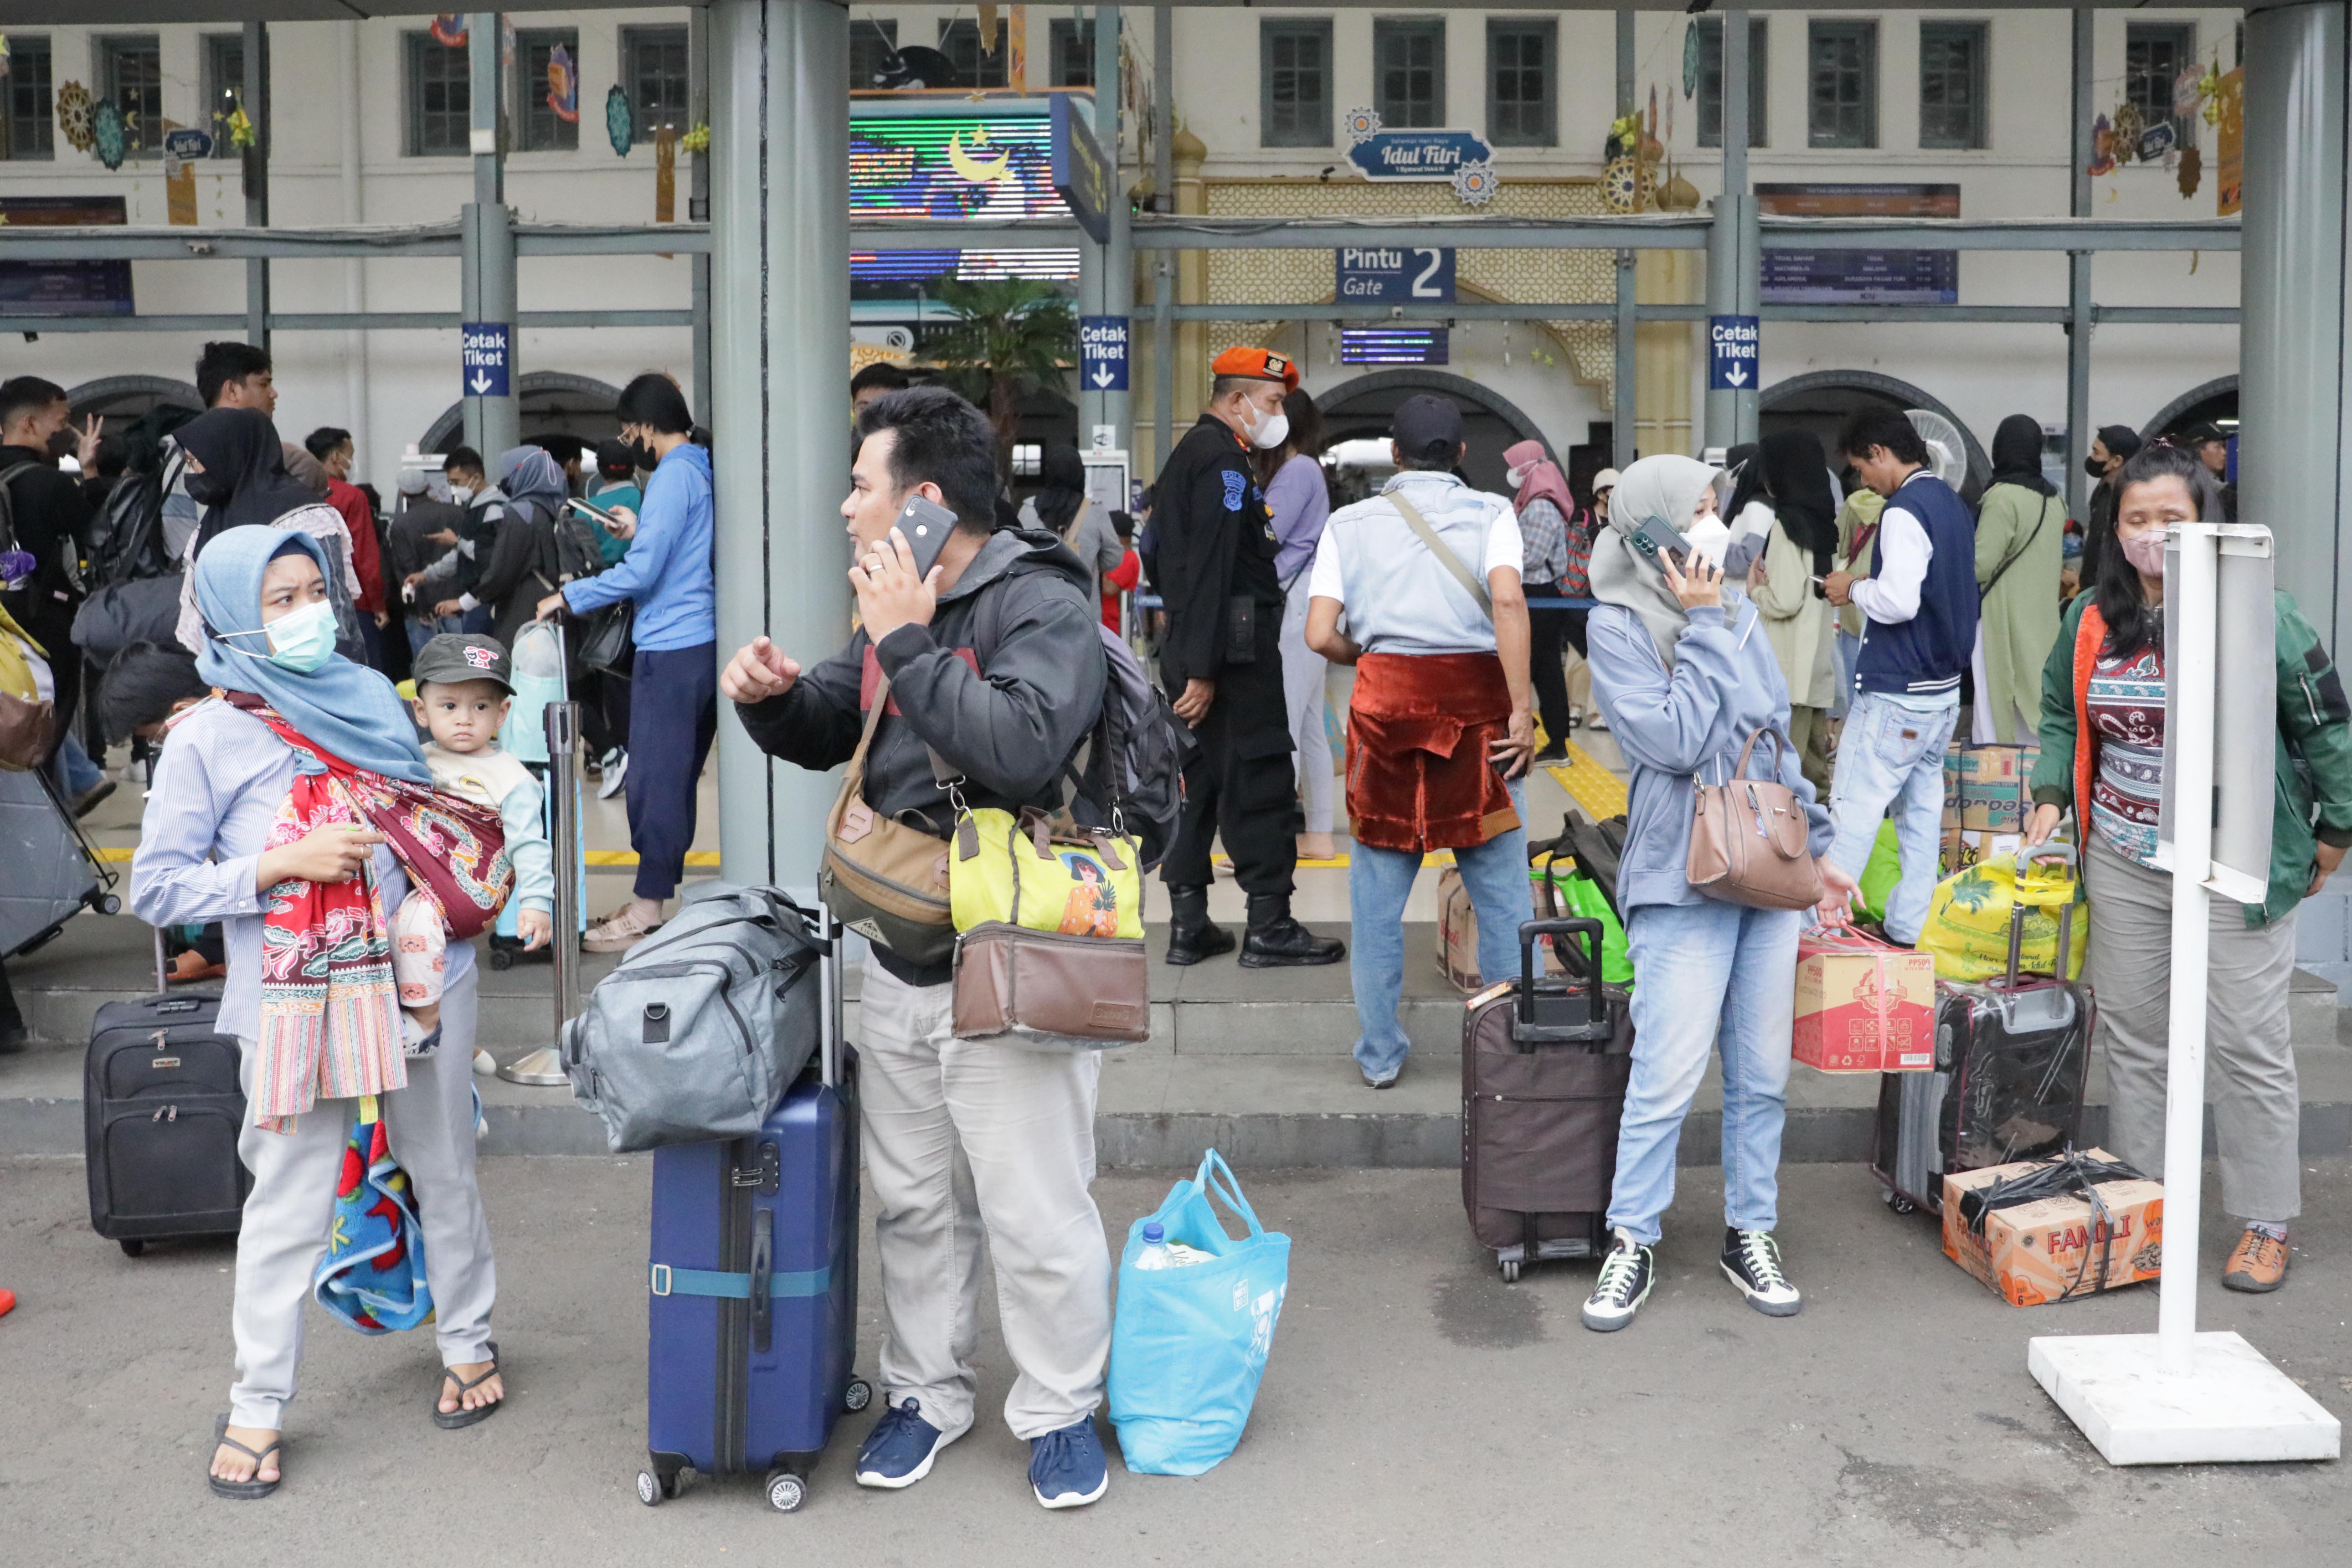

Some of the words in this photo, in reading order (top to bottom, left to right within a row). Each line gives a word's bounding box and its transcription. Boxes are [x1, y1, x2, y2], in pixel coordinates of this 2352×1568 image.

[1381, 146, 1420, 164] Idul
[1423, 145, 1461, 164] Fitri
[1344, 248, 1402, 268] Pintu
[1412, 248, 1442, 297] 2
[1343, 277, 1383, 295] Gate
[463, 333, 506, 349] Cetak
[1081, 326, 1127, 342] Cetak
[1712, 325, 1758, 341] Cetak
[464, 349, 503, 365] Tiket
[1083, 343, 1124, 359] Tiket
[1715, 343, 1756, 358] Tiket
[860, 926, 879, 939] EIGER
[2018, 1295, 2023, 1305] 6
